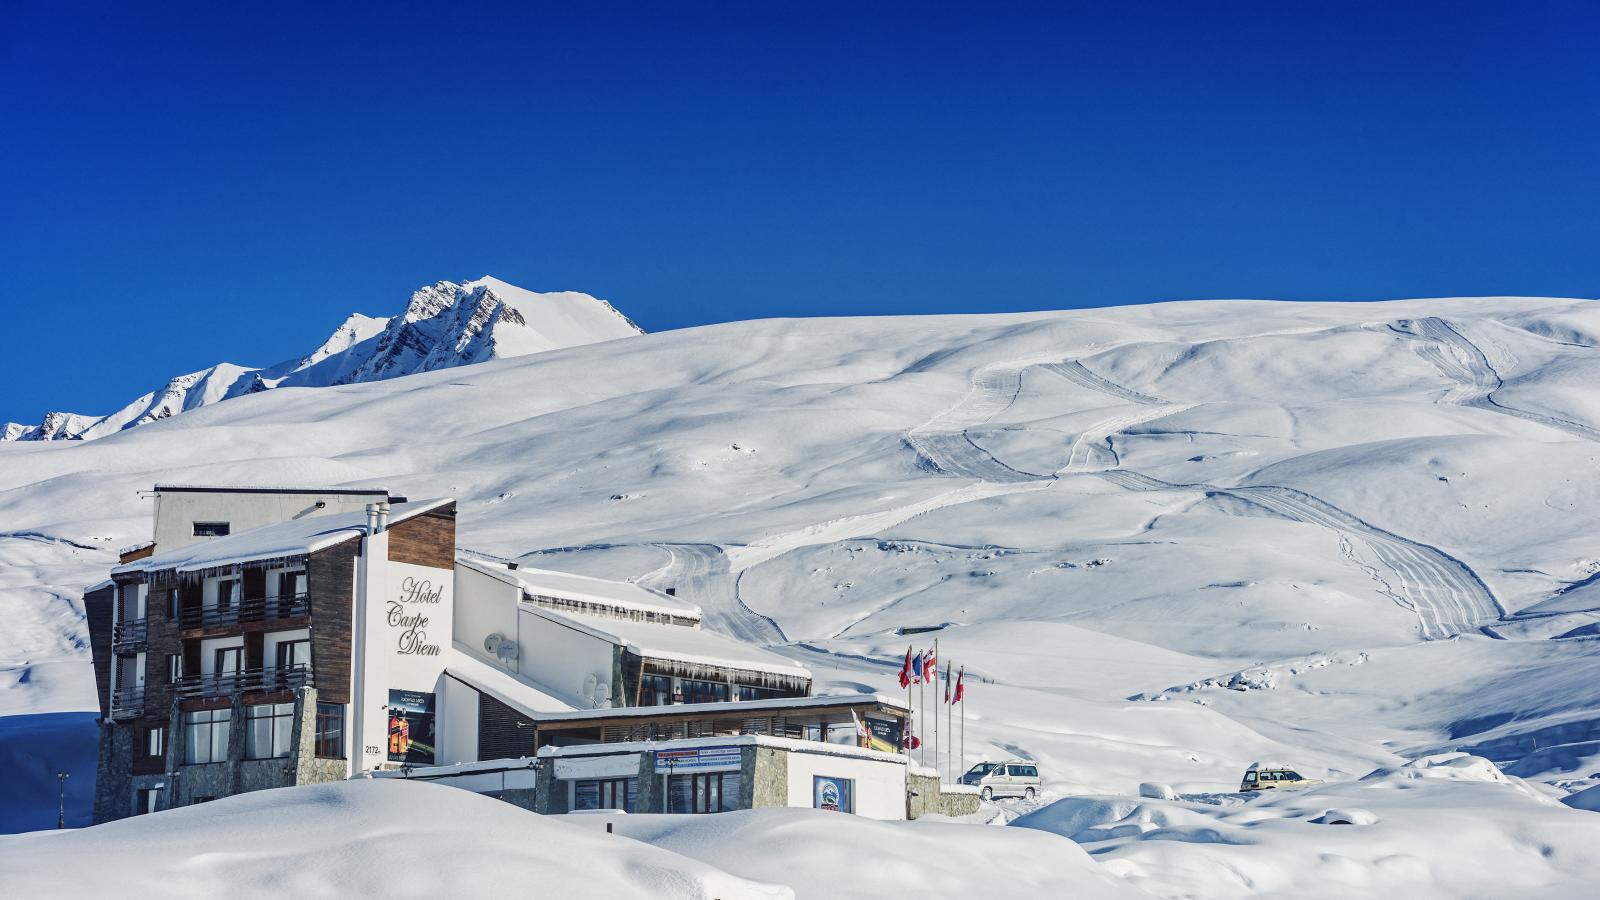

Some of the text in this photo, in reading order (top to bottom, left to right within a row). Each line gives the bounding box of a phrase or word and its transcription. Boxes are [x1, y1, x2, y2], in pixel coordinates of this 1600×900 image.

[400, 576, 444, 604] Hotel
[386, 600, 429, 636] Carpe
[397, 630, 441, 656] Diem
